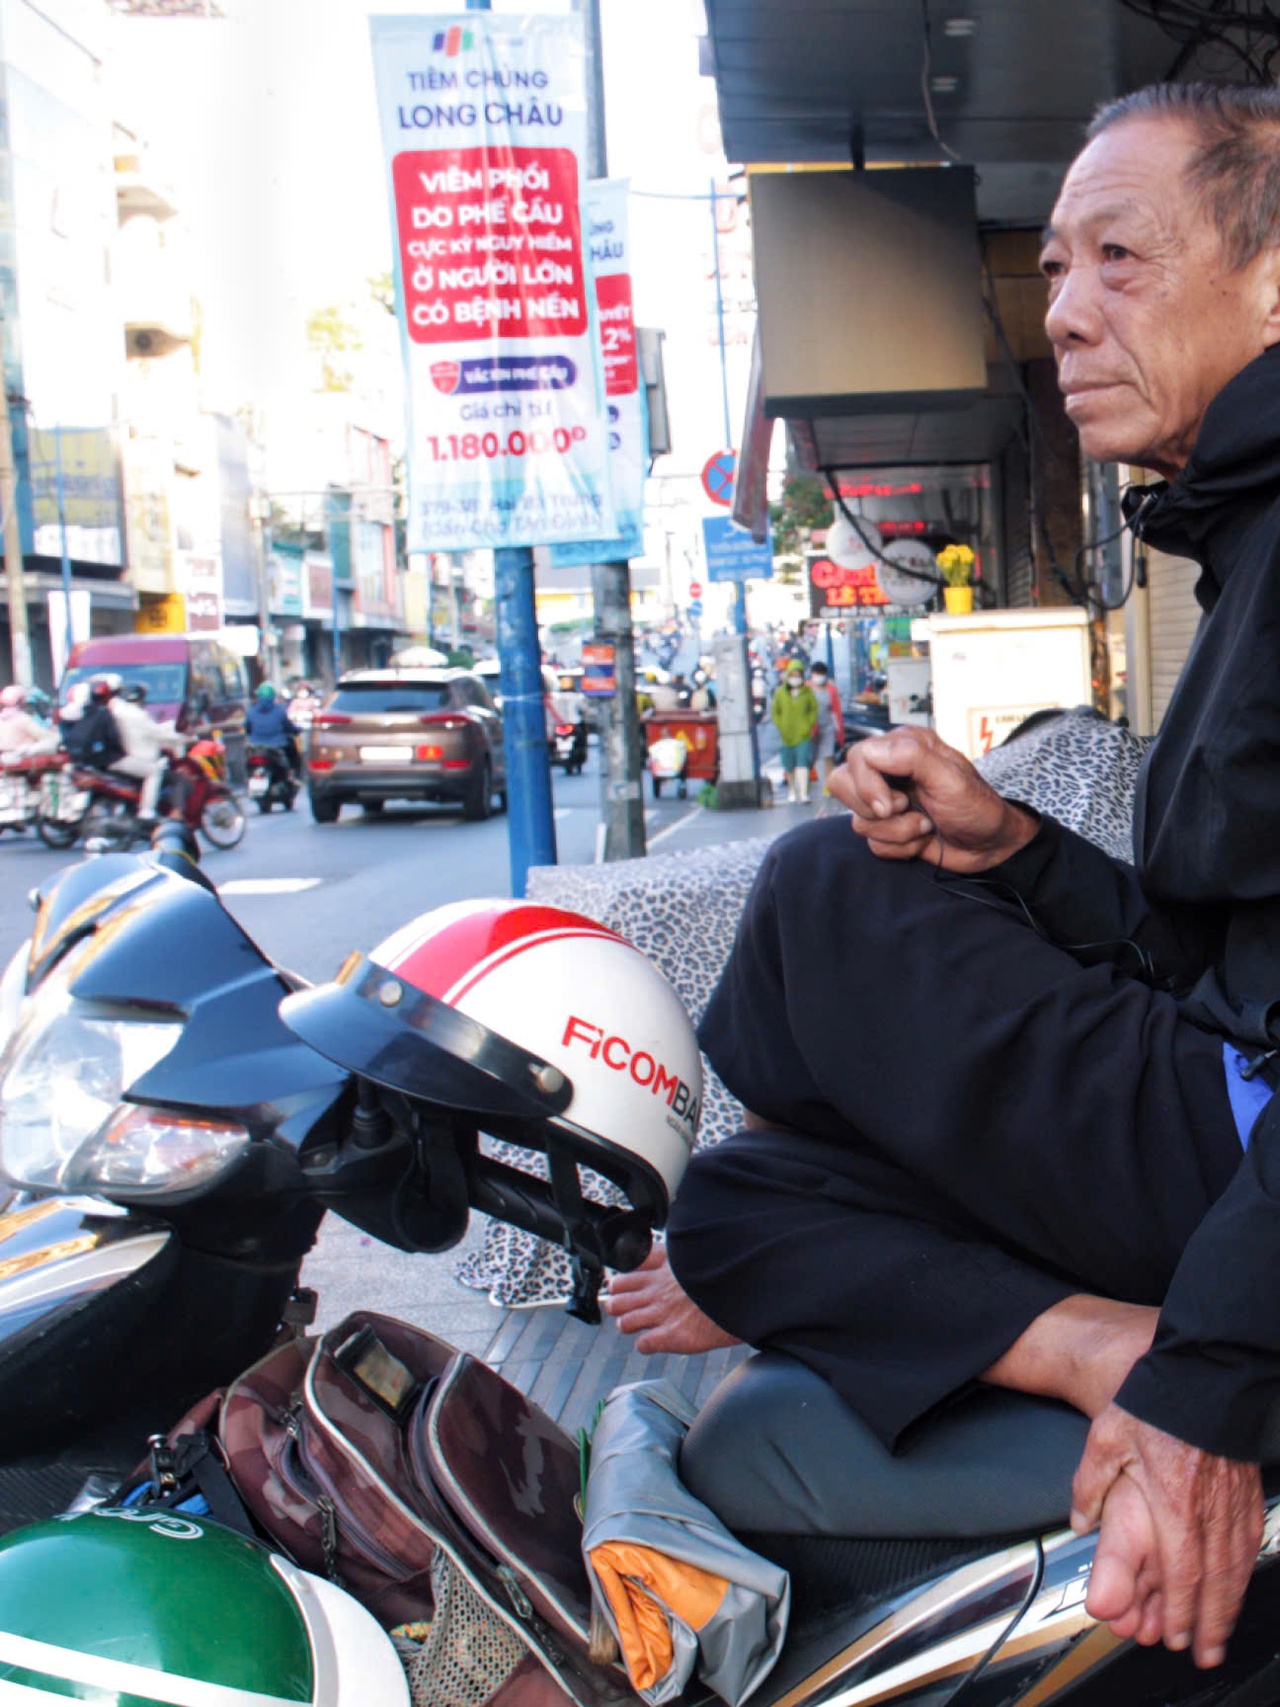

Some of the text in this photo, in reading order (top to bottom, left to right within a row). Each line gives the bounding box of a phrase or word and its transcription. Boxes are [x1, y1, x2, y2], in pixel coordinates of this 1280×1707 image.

[398, 96, 563, 129] LONG CHÂU
[420, 166, 483, 193] VIÊM
[412, 206, 453, 229] DO
[413, 298, 449, 326] CÓ
[454, 296, 522, 328] BỆNH
